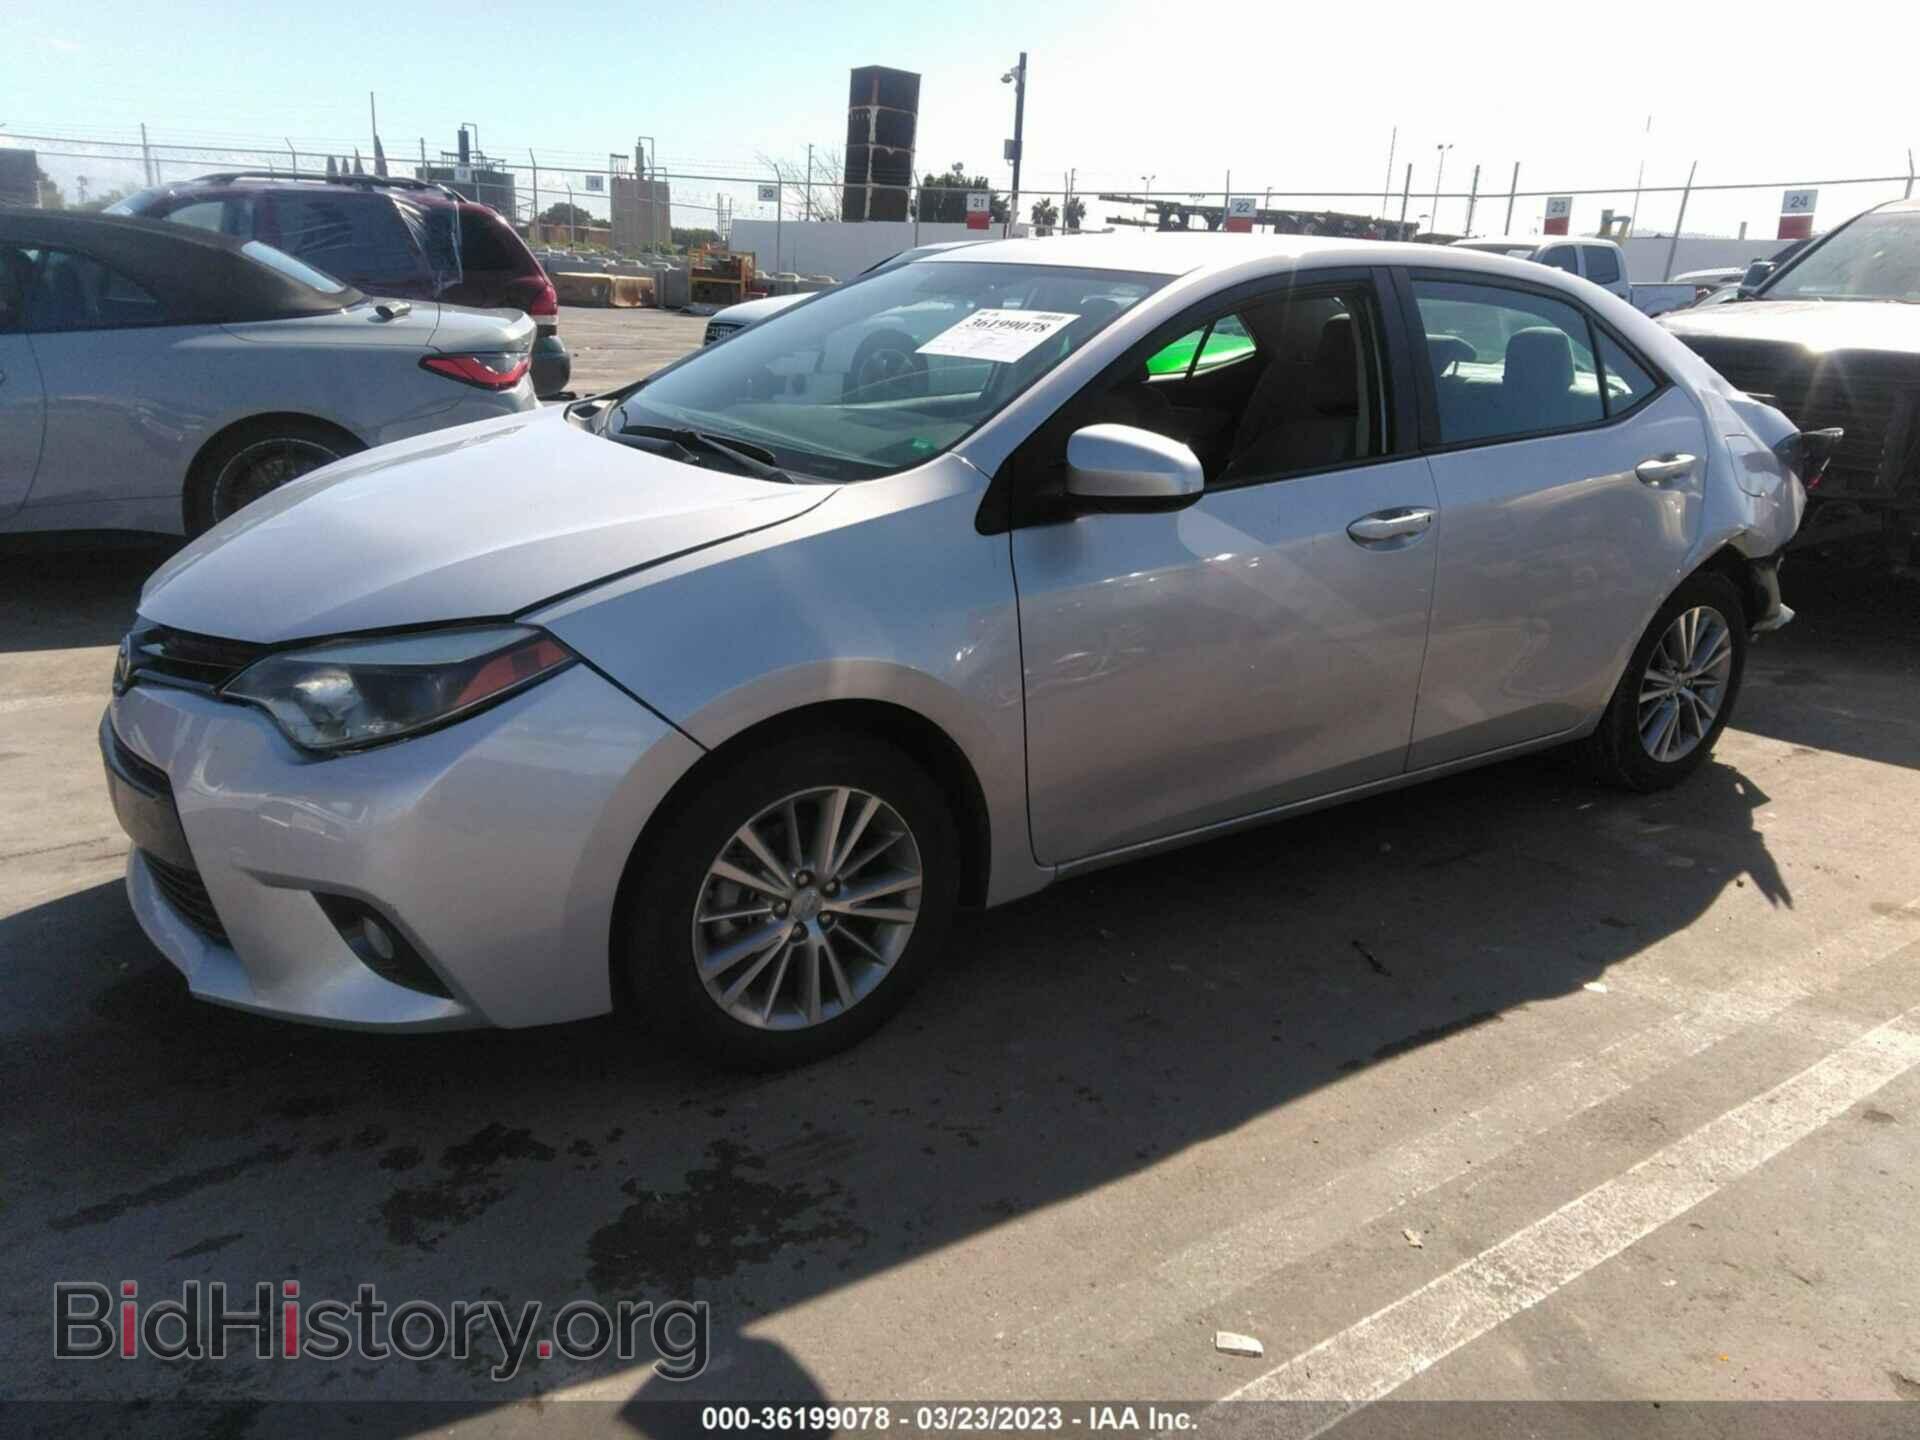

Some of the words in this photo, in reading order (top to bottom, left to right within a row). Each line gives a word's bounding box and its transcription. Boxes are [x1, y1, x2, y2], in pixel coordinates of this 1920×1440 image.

[973, 198, 985, 208] 21
[1235, 202, 1250, 213] 22
[1551, 201, 1567, 213] 23
[1790, 195, 1808, 208] 24
[966, 318, 1051, 333] 36199078
